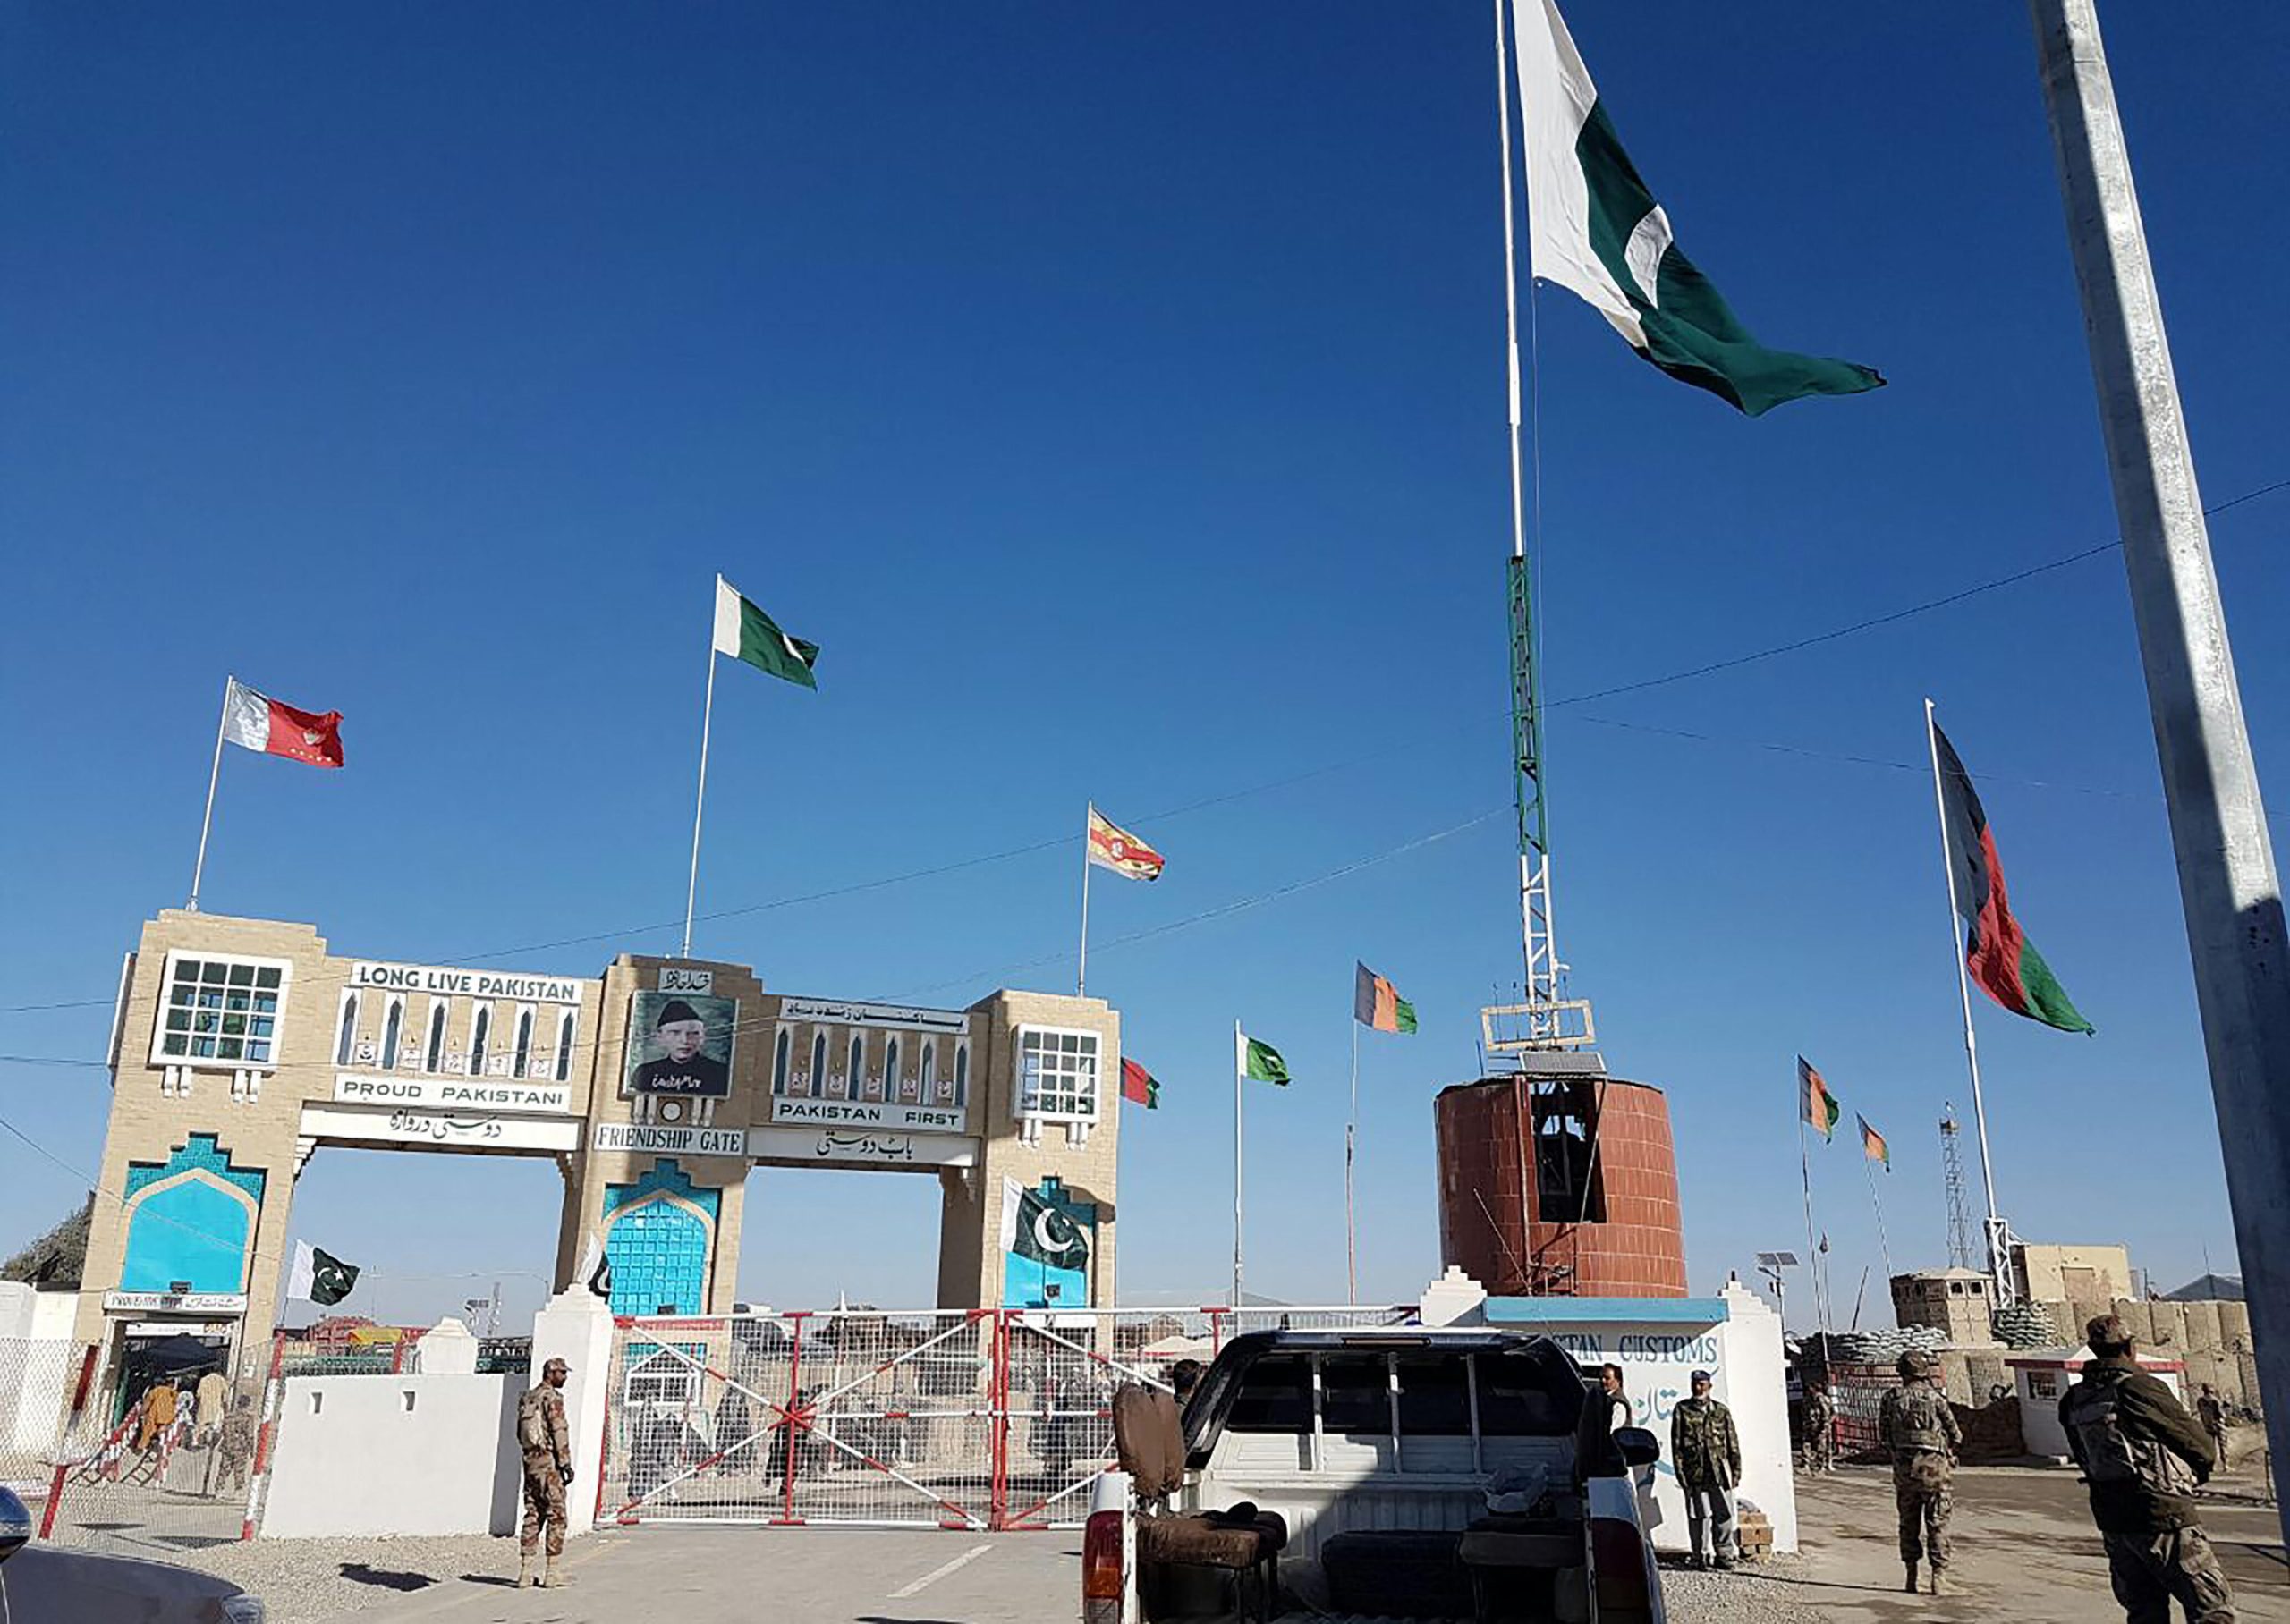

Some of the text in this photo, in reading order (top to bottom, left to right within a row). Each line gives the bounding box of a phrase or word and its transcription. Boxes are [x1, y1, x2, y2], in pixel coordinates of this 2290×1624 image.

[359, 966, 575, 1000] LONG LIVE PAKISTAN
[344, 1081, 563, 1104] PROUD PAKISTANI
[779, 1104, 960, 1126] PAKISTAN FIRST
[598, 1126, 741, 1153] FRIENDSHIP GATE
[1618, 1334, 1718, 1364] CUSTOMS
